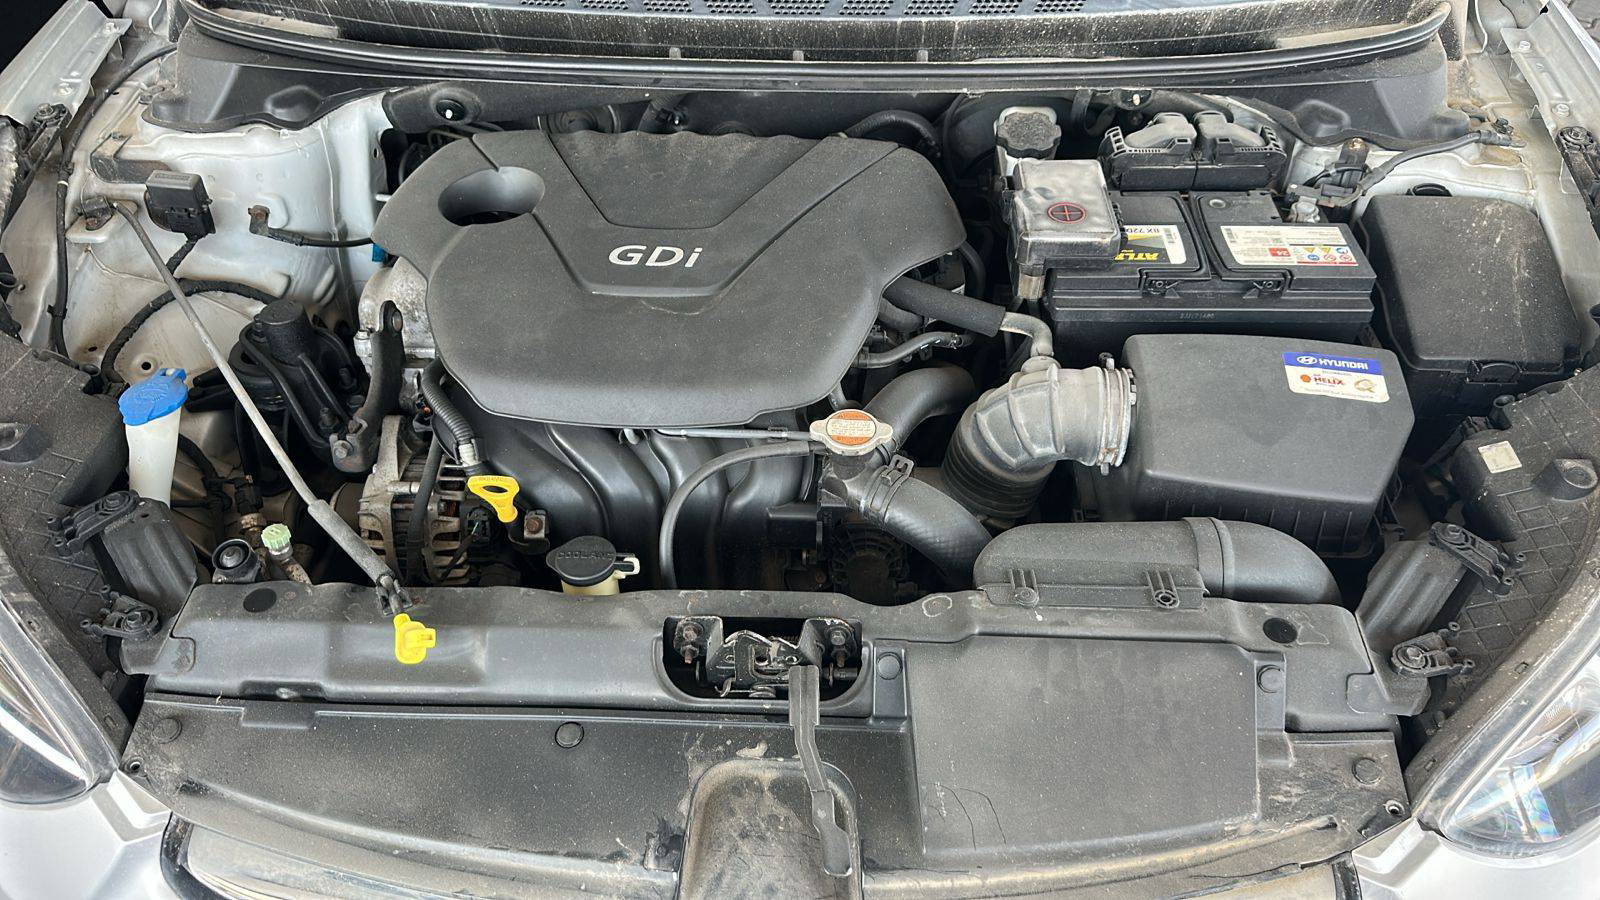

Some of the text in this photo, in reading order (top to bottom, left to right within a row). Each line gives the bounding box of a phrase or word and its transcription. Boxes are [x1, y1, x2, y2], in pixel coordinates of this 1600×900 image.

[608, 244, 703, 268] GDi
[1318, 358, 1369, 371] HYUNDAI
[1313, 377, 1345, 385] HELIX
[558, 551, 615, 561] COOLANT
